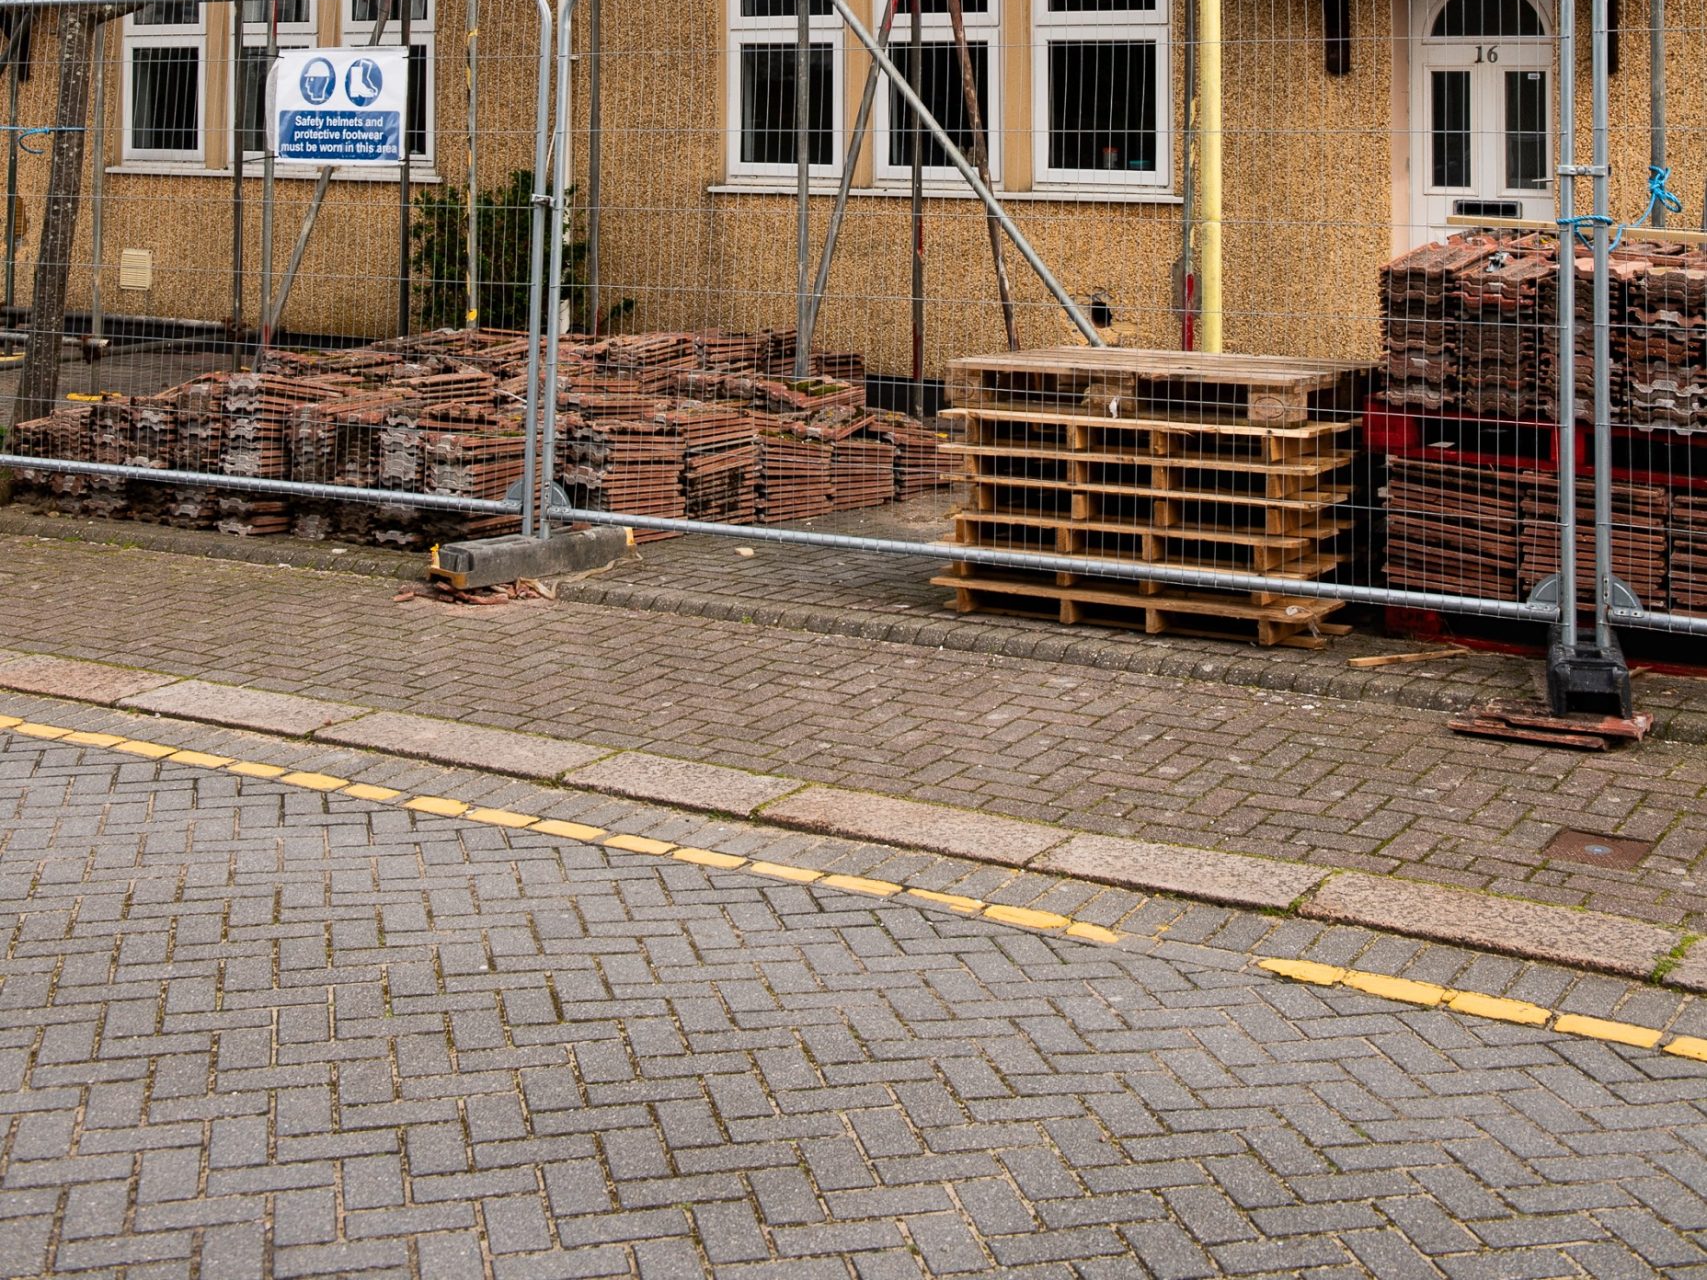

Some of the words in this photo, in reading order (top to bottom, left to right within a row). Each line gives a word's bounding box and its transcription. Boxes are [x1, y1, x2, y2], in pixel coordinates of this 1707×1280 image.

[1474, 45, 1499, 63] 16
[295, 116, 324, 129] Safety
[326, 116, 363, 126] helmets
[366, 116, 383, 127] and
[294, 129, 340, 141] protective
[342, 129, 384, 140] footwear
[281, 142, 304, 152] must
[306, 142, 317, 152] be
[320, 144, 342, 152] worn
[346, 142, 354, 152] in
[356, 142, 374, 153] this
[377, 144, 397, 153] area
